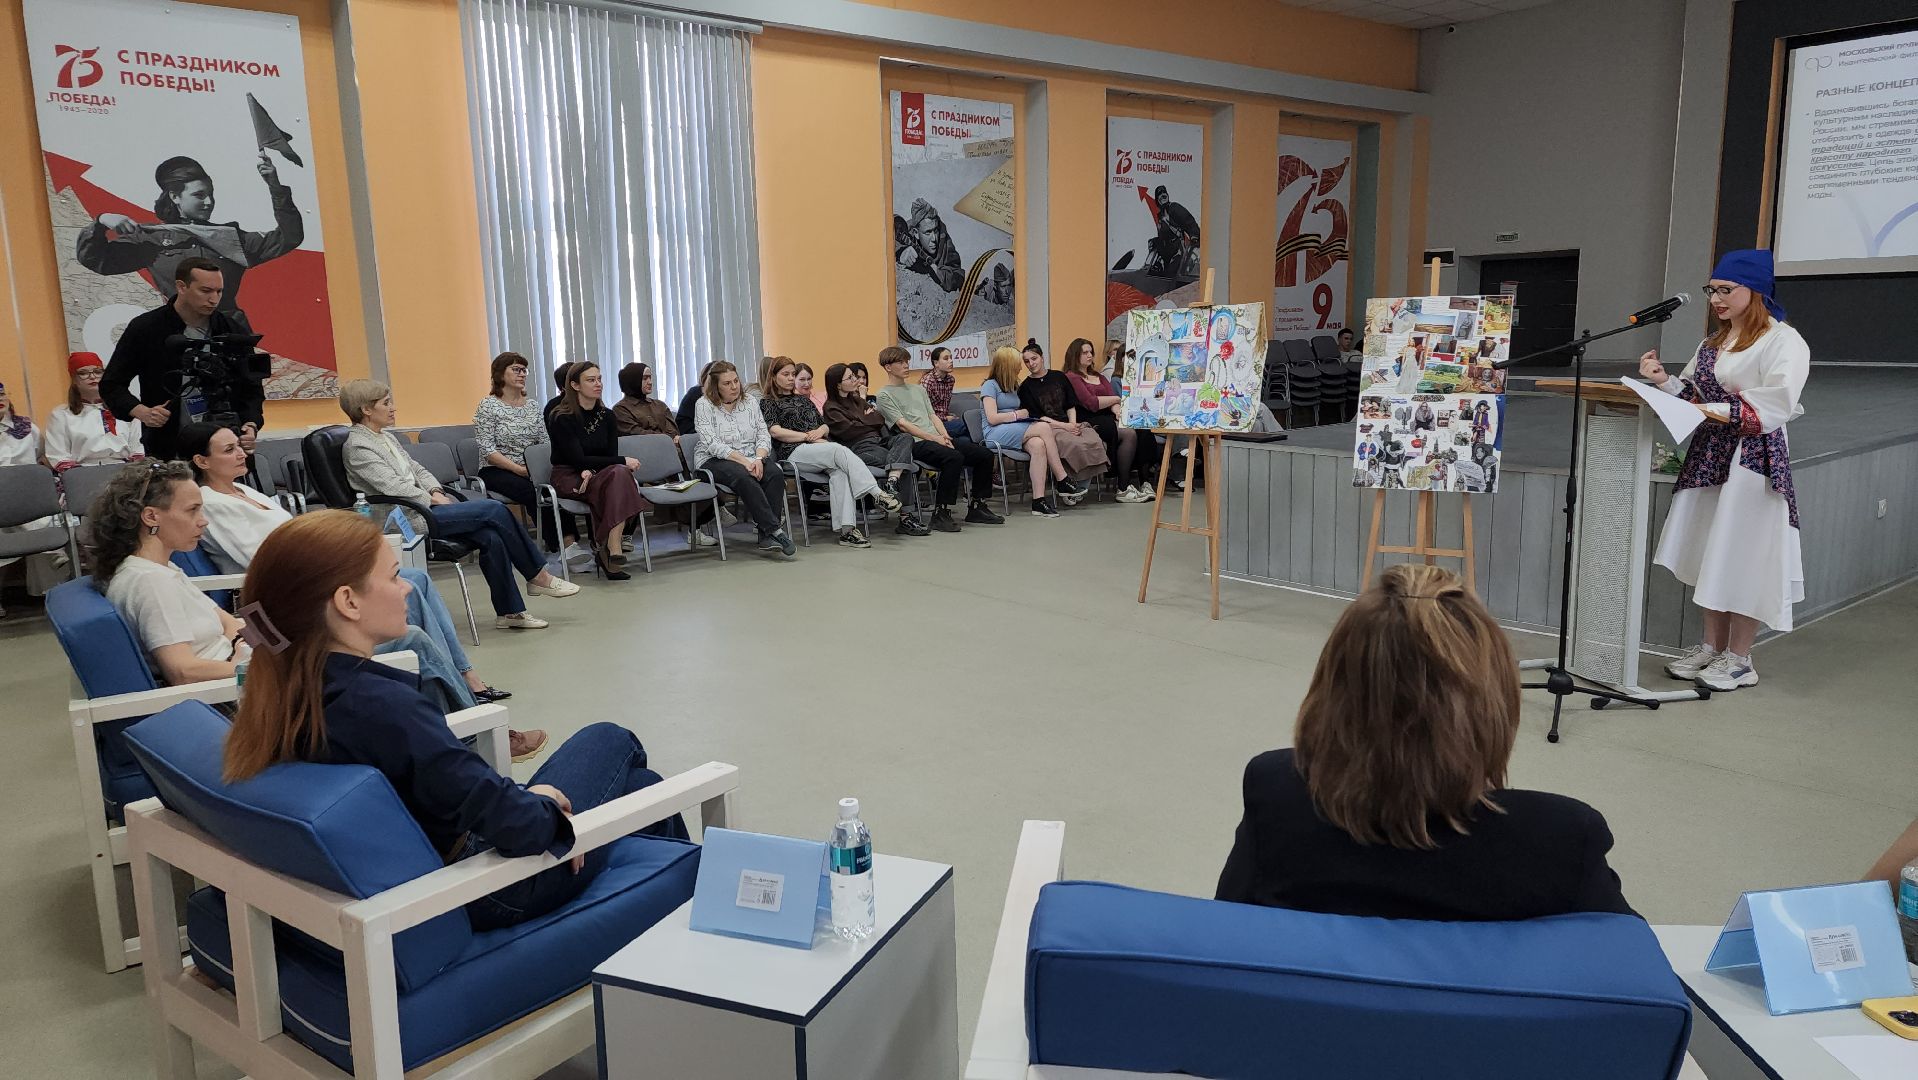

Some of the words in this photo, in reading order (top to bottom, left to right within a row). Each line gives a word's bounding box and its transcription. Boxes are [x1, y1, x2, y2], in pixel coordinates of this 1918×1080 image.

[117, 49, 130, 64] С
[135, 51, 280, 78] ПРАЗДНИКОМ
[120, 70, 215, 93] ПОБЕДЫ!
[1816, 83, 1866, 98] РАЗНЫЕ
[48, 91, 116, 106] ПОБЕДА!
[931, 110, 937, 120] С
[938, 110, 1000, 126] ПРАЗДНИКОМ
[931, 125, 972, 139] ПОБЕДЫ!
[1136, 150, 1142, 158] С
[1143, 151, 1193, 162] ПРАЗДНИКОМ
[1810, 152, 1855, 164] красоту
[1856, 148, 1912, 158] народного
[1869, 159, 1894, 167] Цель
[1136, 163, 1170, 174] ПОБЕДЫ!
[1860, 167, 1903, 176] глубокие
[1312, 282, 1333, 330] 9
[954, 347, 979, 360] 2020
